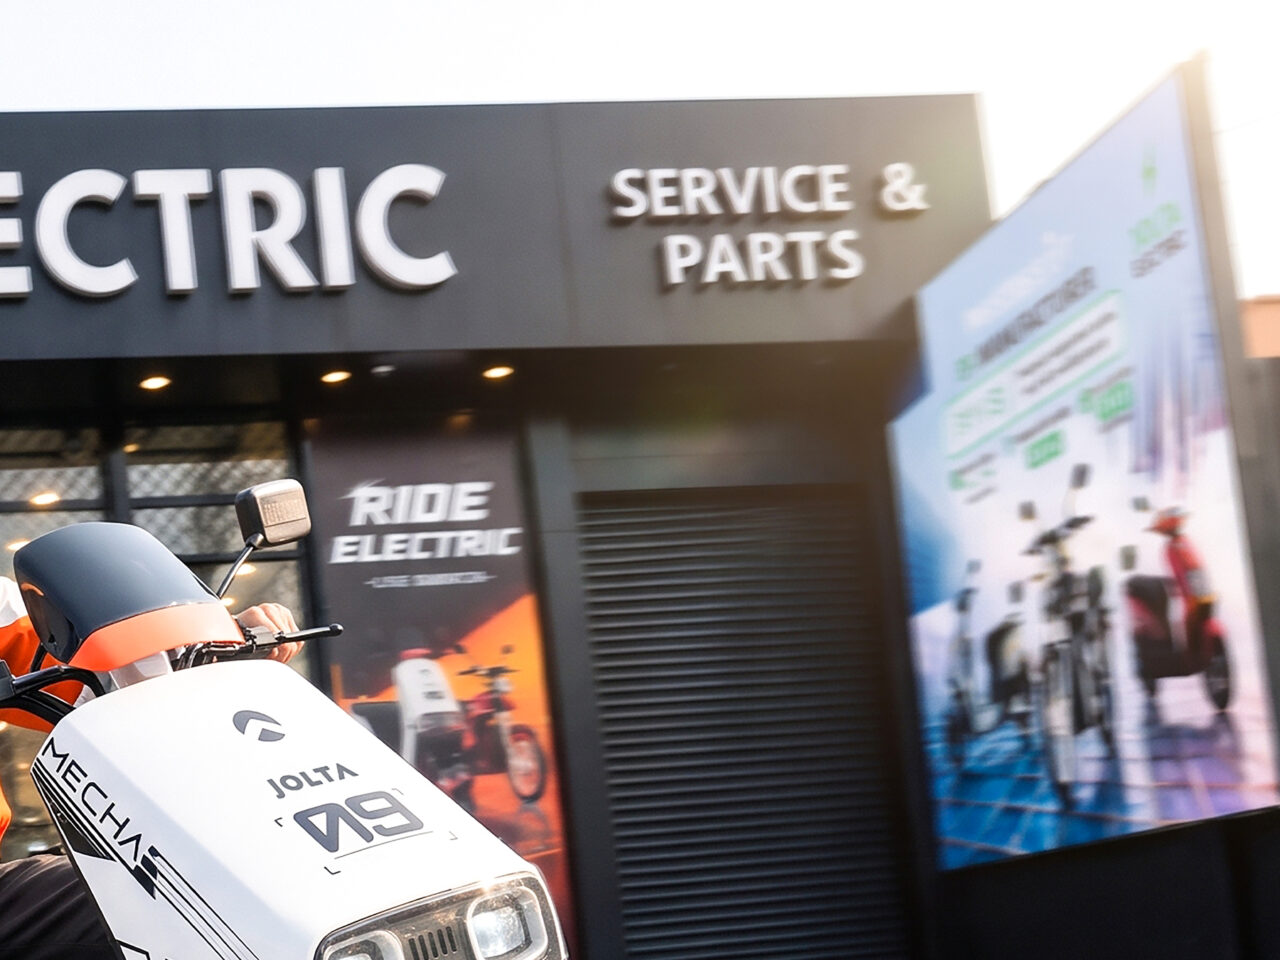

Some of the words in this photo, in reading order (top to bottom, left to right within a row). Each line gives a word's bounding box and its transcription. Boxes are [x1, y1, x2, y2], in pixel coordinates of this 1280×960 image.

[611, 164, 856, 218] SERVICE
[880, 161, 932, 212] &
[663, 229, 865, 284] PARTS
[341, 480, 495, 527] RIDE
[328, 527, 524, 565] ELECTRIC
[41, 736, 143, 863] MECHA
[266, 762, 360, 800] JOLTA
